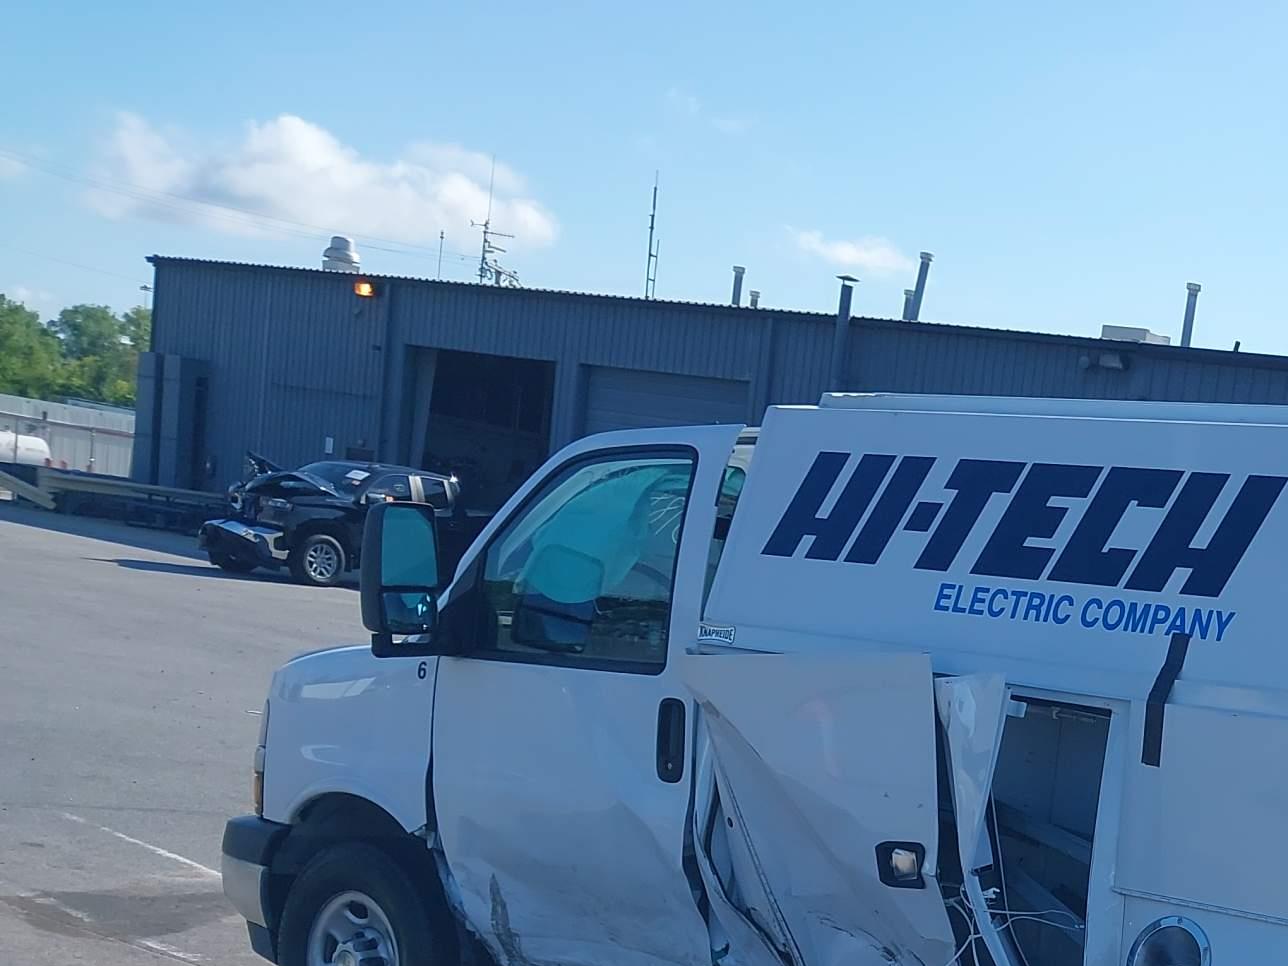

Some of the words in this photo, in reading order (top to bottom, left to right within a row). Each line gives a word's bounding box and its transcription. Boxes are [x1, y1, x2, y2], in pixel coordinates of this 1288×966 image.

[932, 582, 1076, 626] ELECTRIC
[1080, 597, 1238, 643] COMPANY
[417, 660, 428, 680] 6
